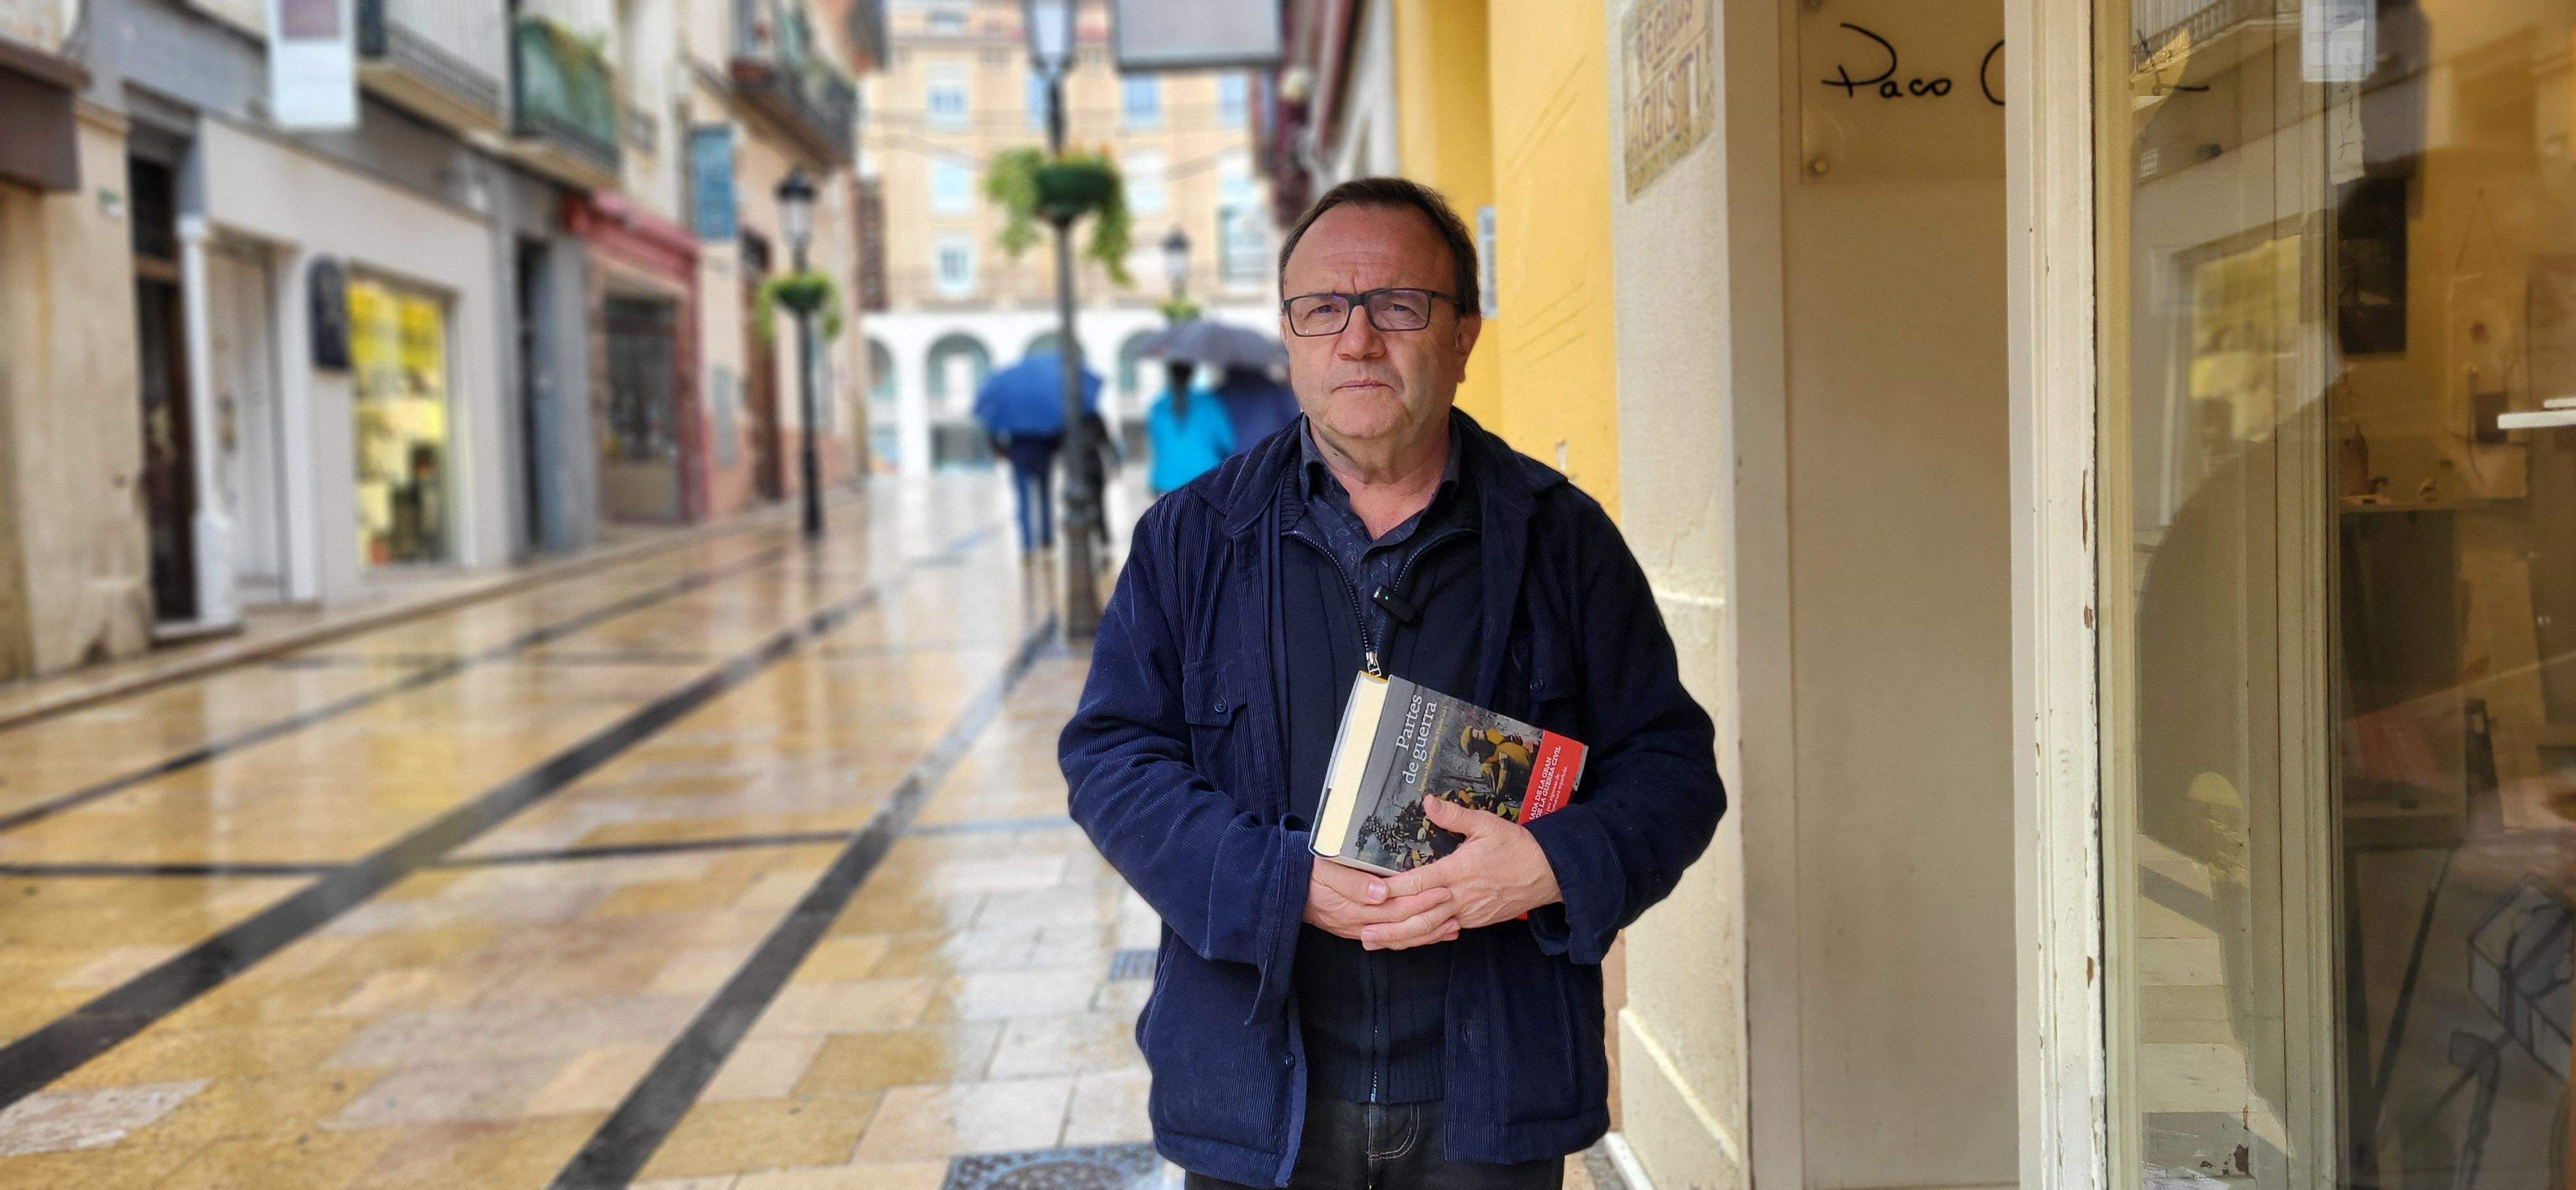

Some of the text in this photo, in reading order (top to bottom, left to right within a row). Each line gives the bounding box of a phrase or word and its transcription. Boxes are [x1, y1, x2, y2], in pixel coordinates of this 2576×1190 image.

[1821, 23, 1952, 98] Paco
[1396, 695, 1423, 751] Partes
[1403, 762, 1419, 784] de
[1413, 702, 1437, 762] guerra
[1536, 746, 1561, 818] DE LA GUERRA CIVIL
[1538, 779, 1546, 789] LA
[1542, 756, 1552, 778] GRAN
[1535, 789, 1542, 802] DE
